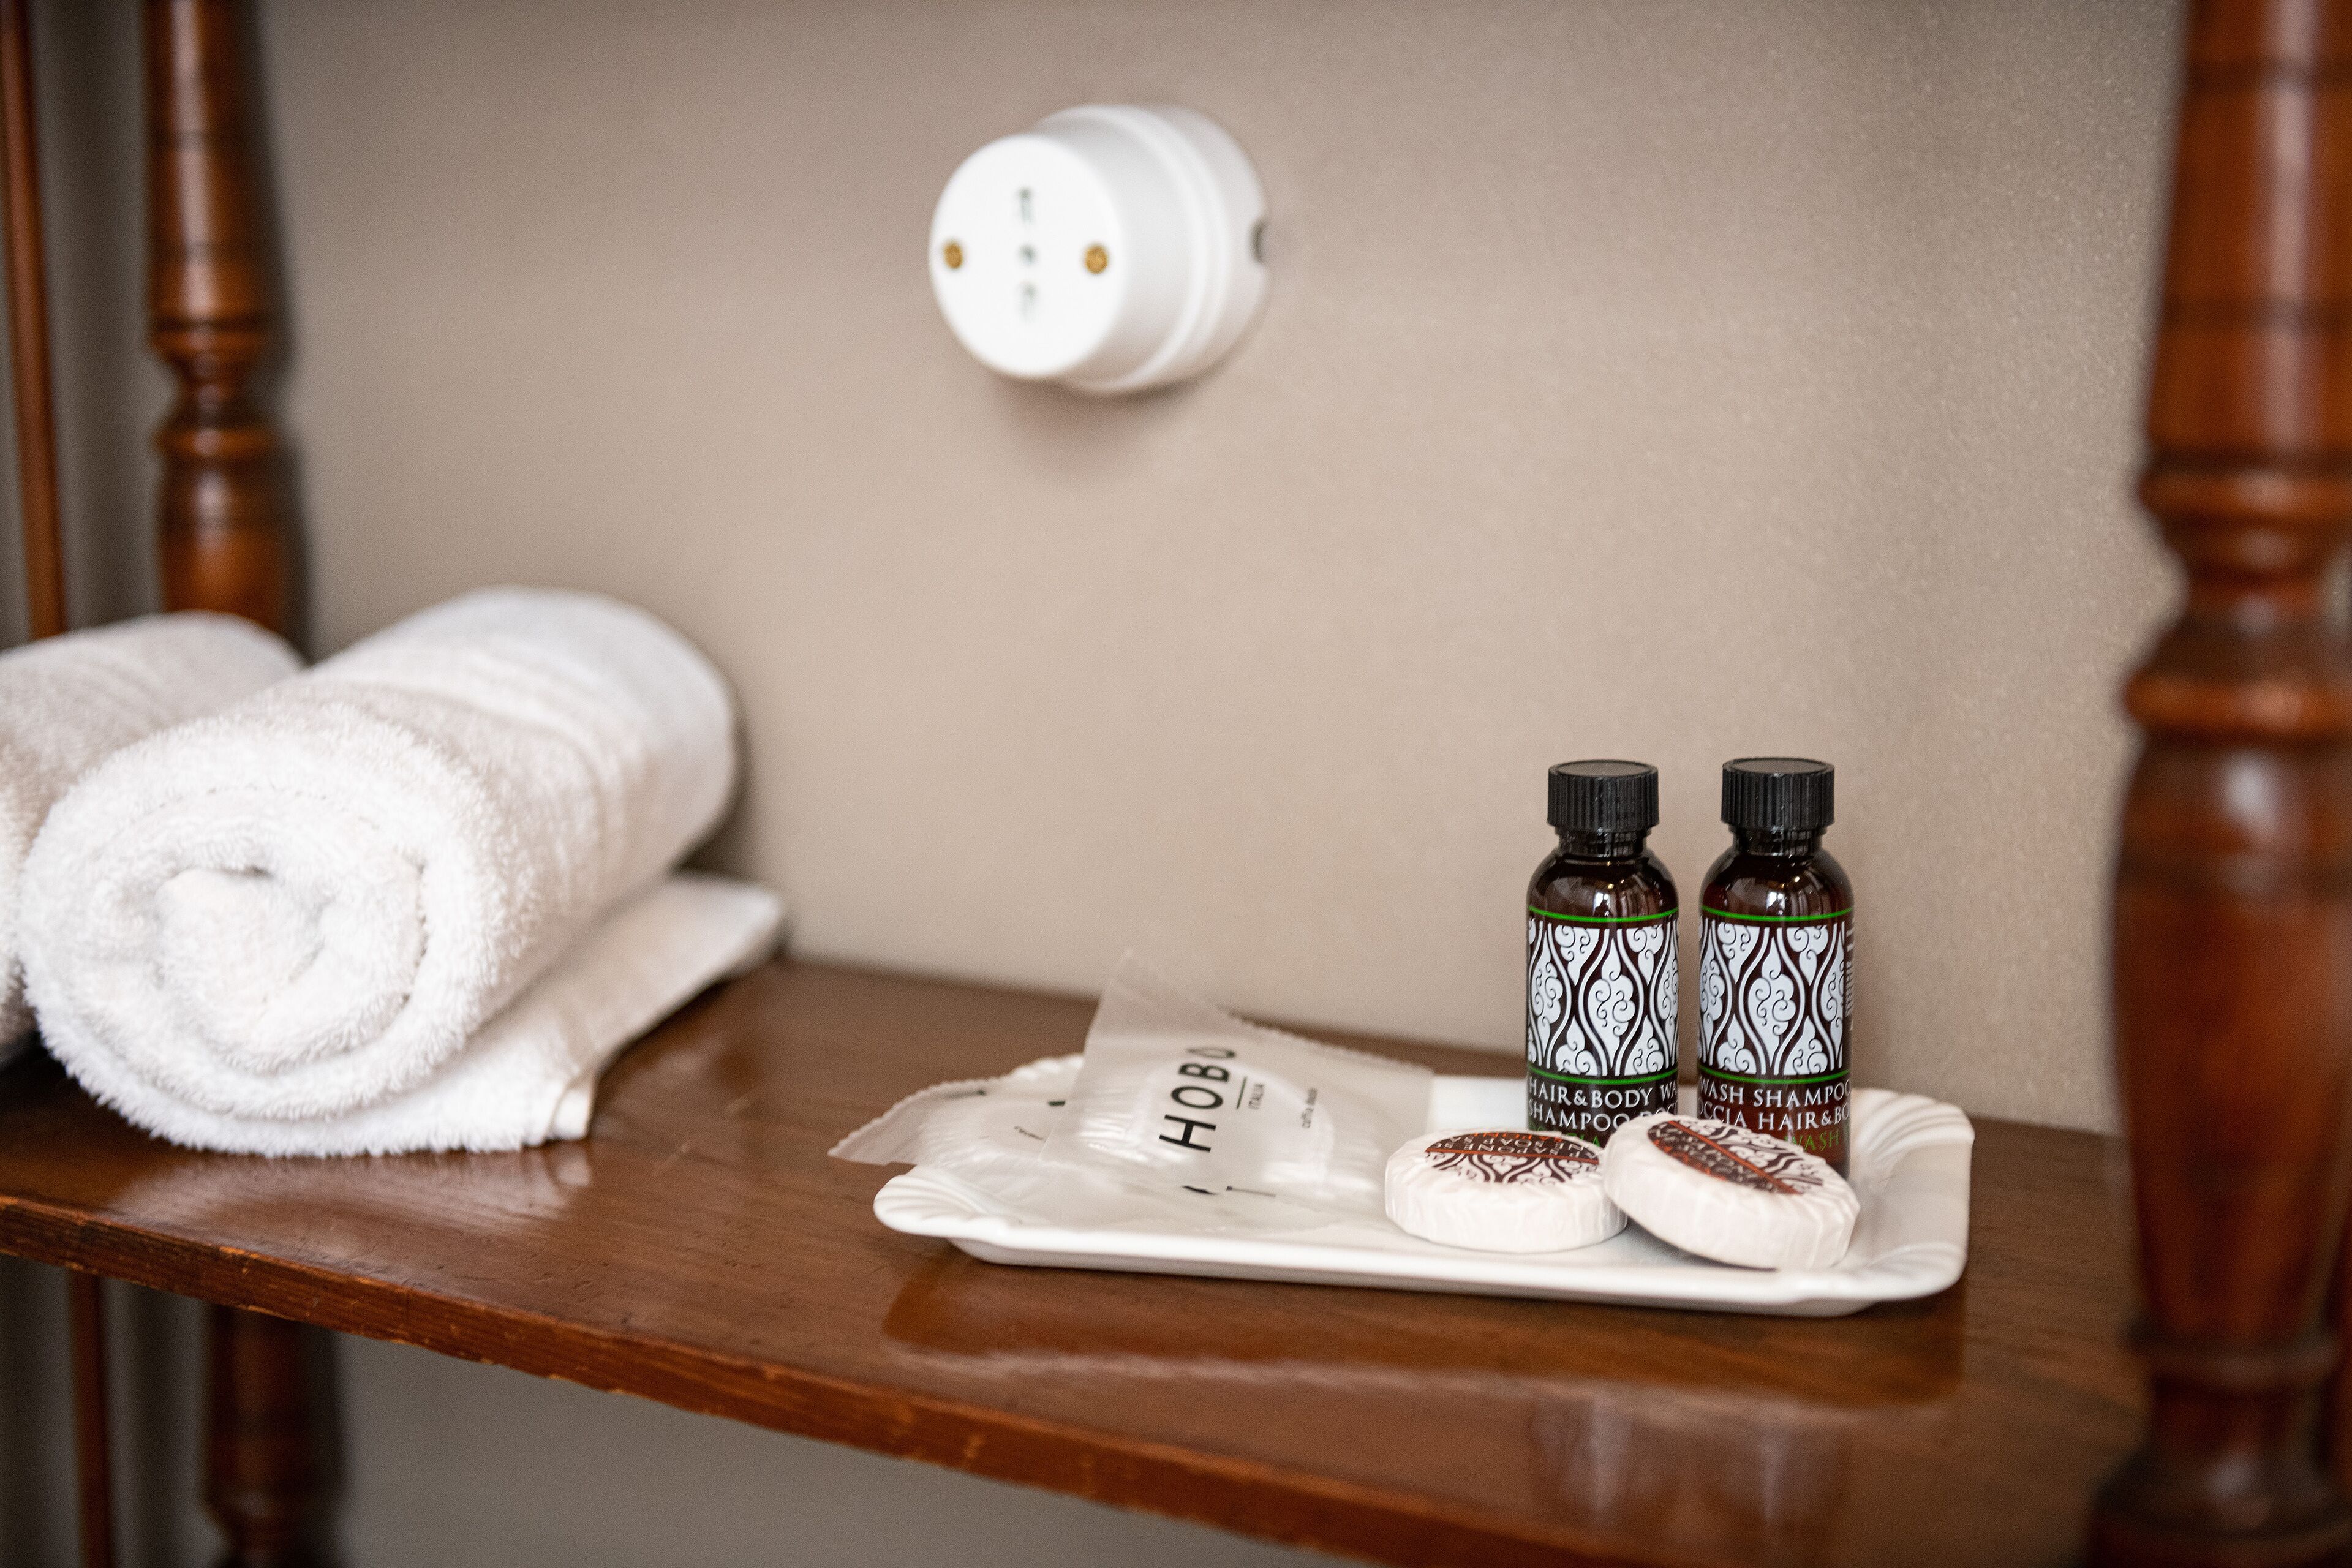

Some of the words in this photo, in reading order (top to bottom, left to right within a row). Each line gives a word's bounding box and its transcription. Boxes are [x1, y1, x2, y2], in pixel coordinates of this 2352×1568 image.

[1159, 1046, 1236, 1153] HOBO
[1529, 1076, 1654, 1109] HAIR&BODY
[1700, 1076, 1745, 1105] WASH
[1754, 1078, 1851, 1108] SHAMPOO
